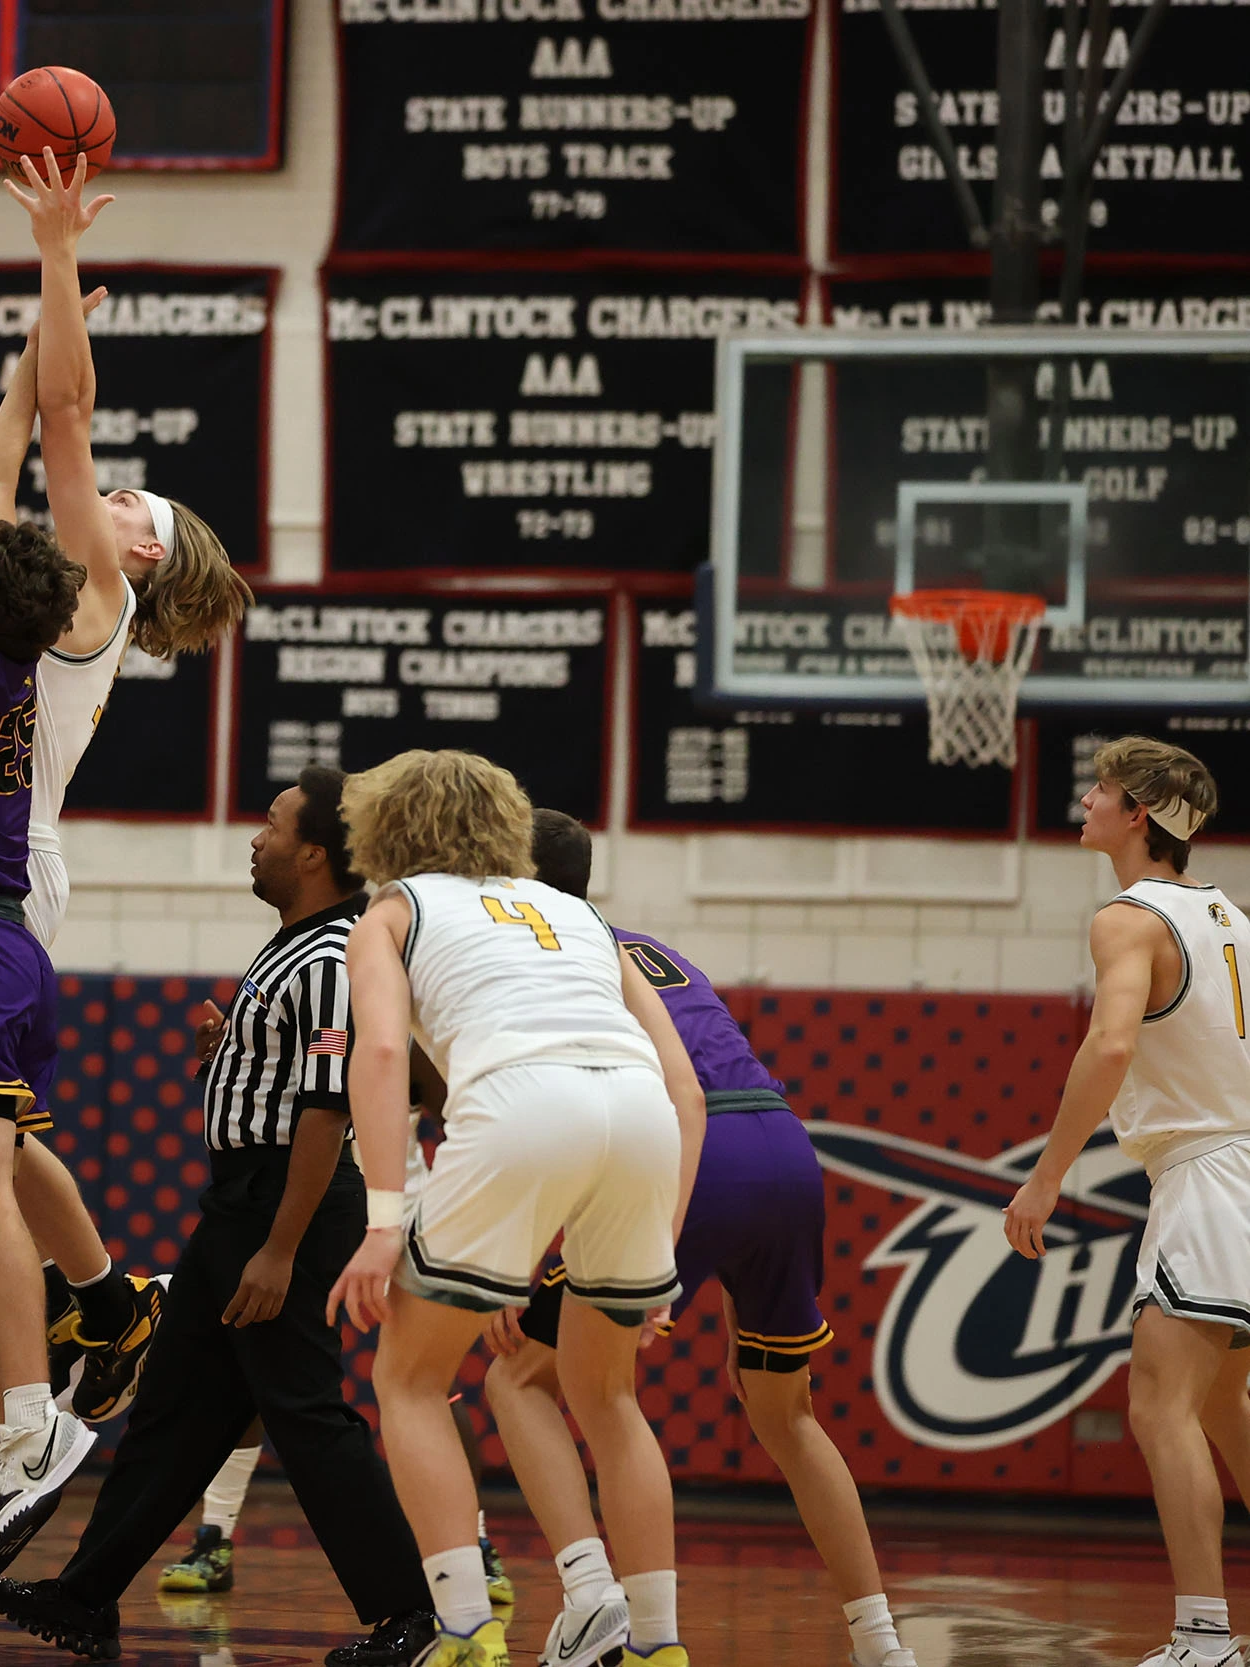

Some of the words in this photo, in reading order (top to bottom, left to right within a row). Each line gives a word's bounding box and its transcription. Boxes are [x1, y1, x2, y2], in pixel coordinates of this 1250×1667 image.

[530, 38, 612, 78] AAA
[405, 96, 506, 132] STATE
[519, 95, 736, 131] RUNNERS-UP
[463, 144, 549, 180] BOYS
[562, 143, 673, 179] TRACK
[520, 354, 601, 396] AAA
[395, 411, 496, 447] STATE
[461, 461, 651, 497] WRESTLING
[442, 610, 602, 647] CHARGERS
[480, 895, 562, 951] 4
